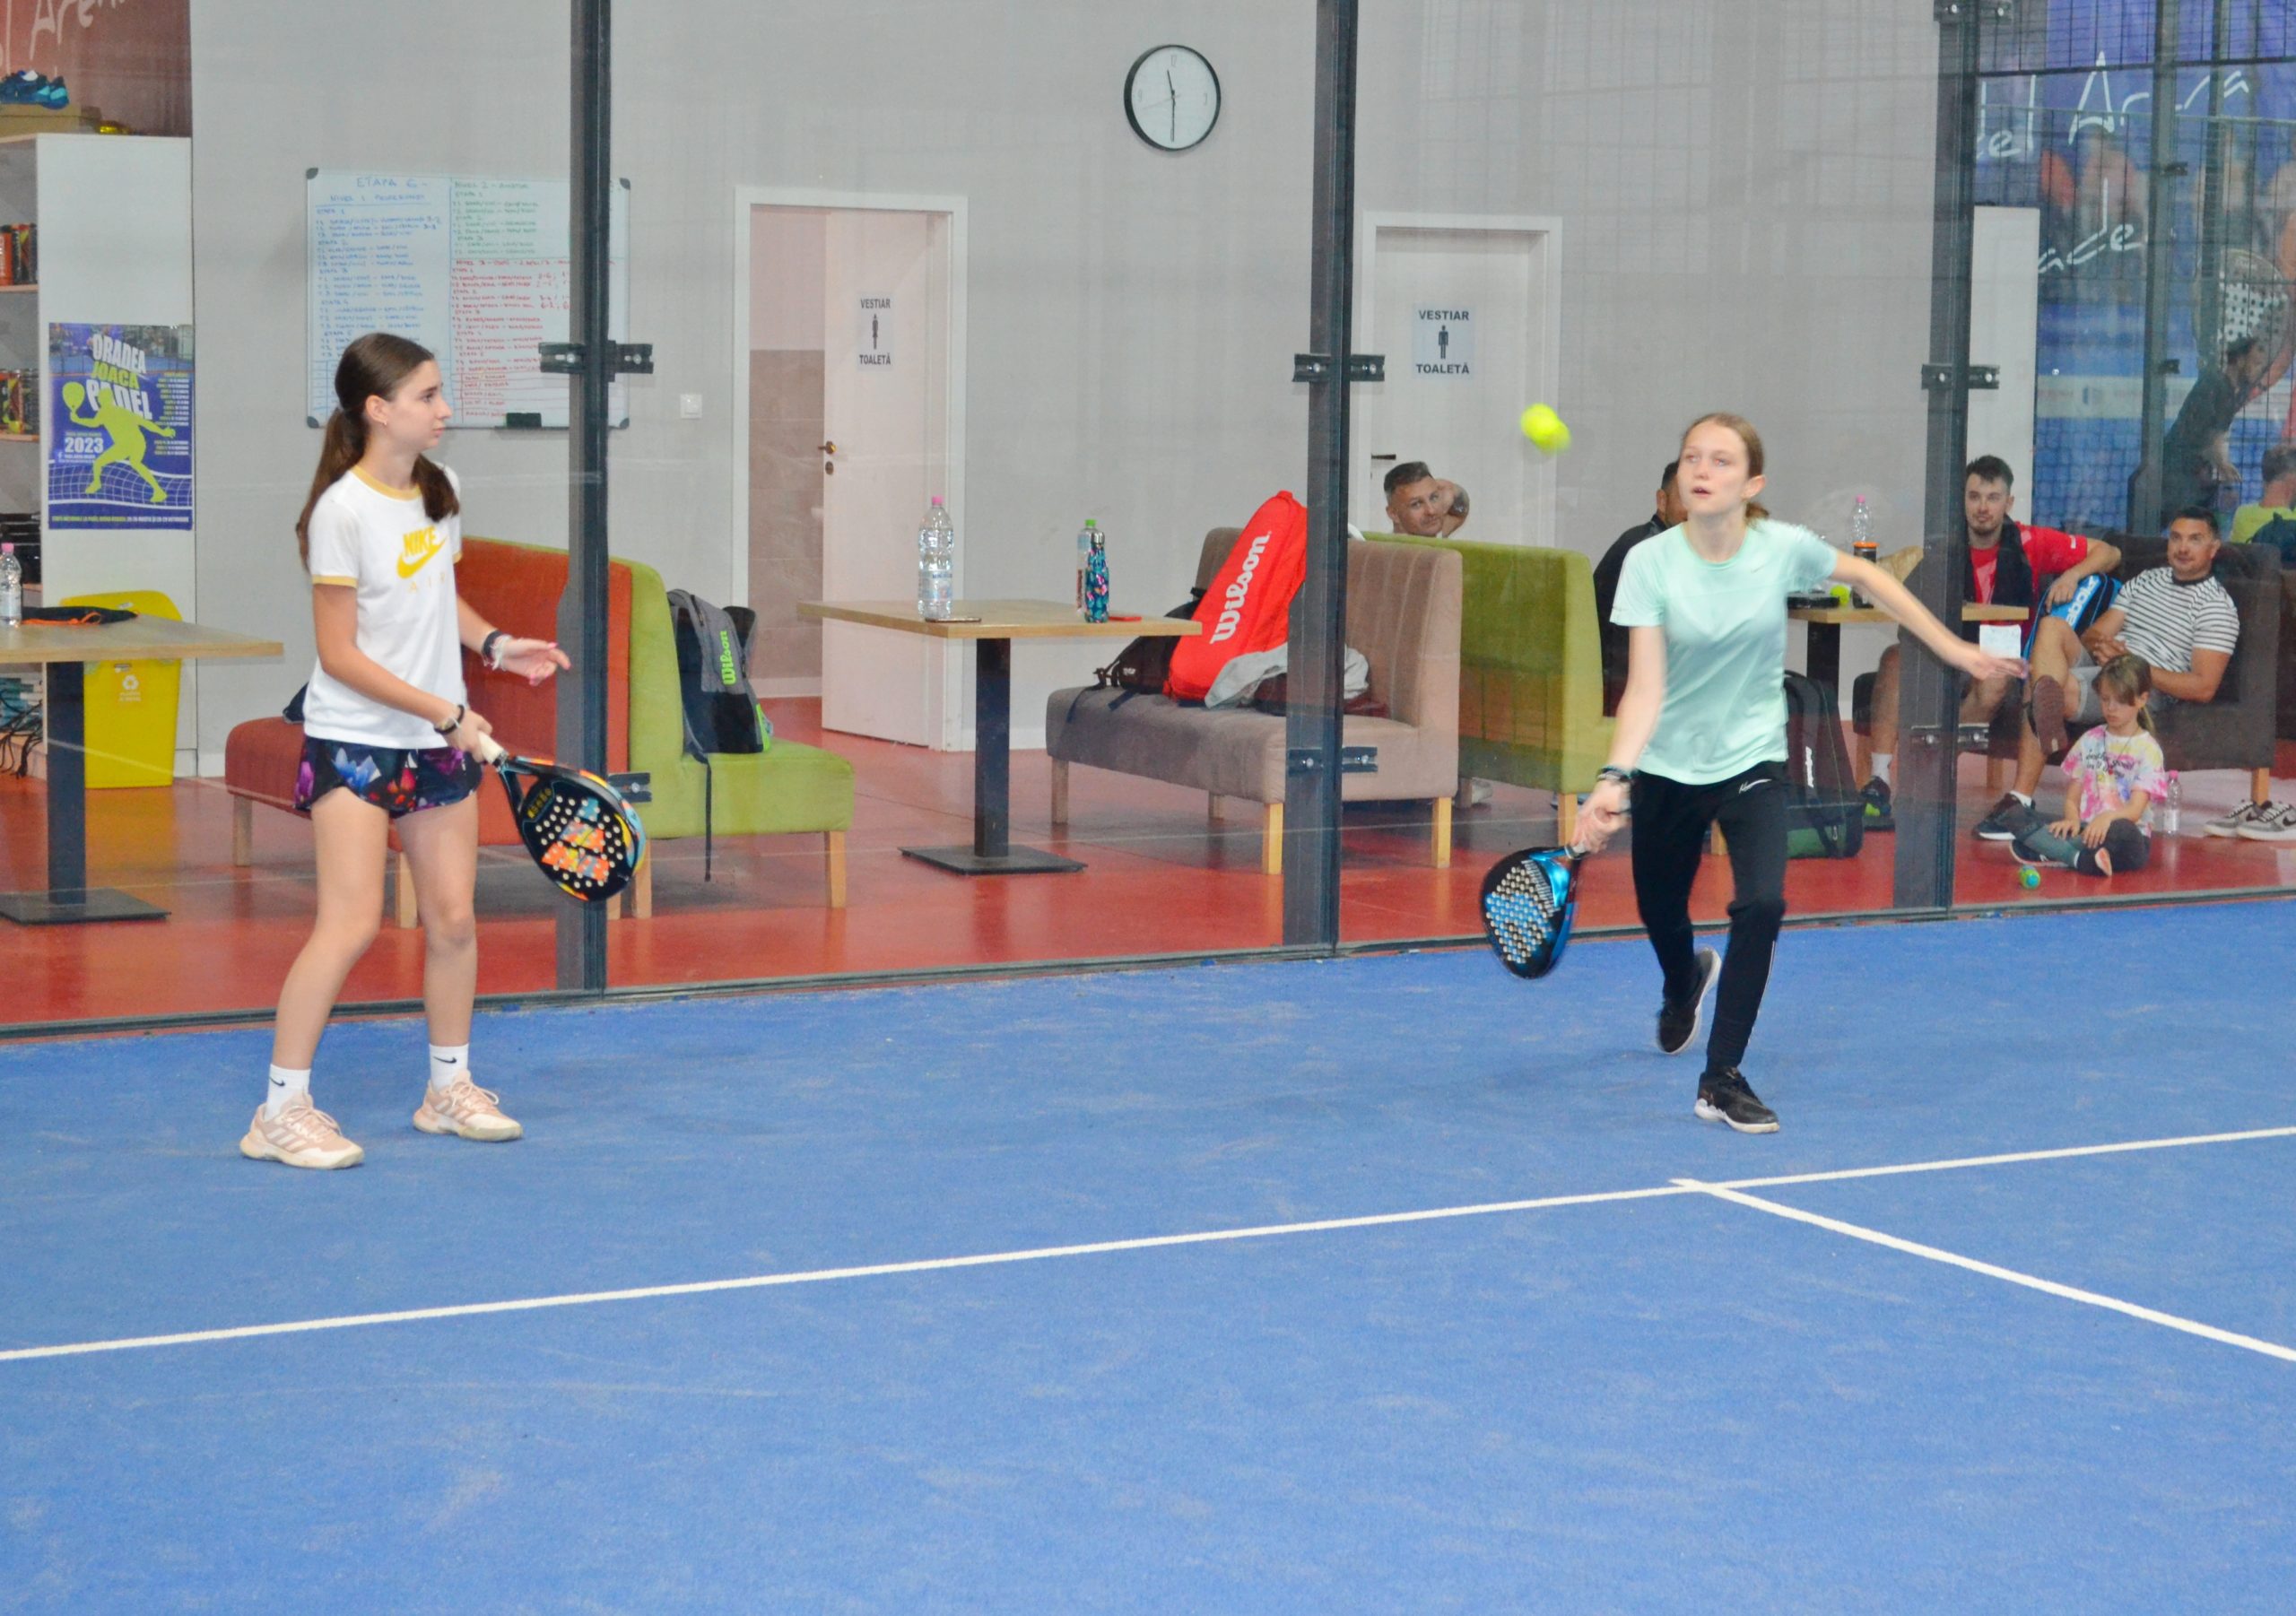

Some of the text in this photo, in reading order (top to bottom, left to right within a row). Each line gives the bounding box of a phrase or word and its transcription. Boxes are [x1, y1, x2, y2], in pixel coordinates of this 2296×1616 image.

[357, 177, 397, 188] ETAPA
[860, 298, 891, 309] VESTIAR
[1418, 310, 1470, 321] VESTIAR
[92, 334, 147, 374] ORADEA
[65, 437, 104, 453] 2023
[403, 526, 436, 556] NIKE
[1209, 530, 1272, 645] Wilson
[719, 630, 736, 686] Wilson
